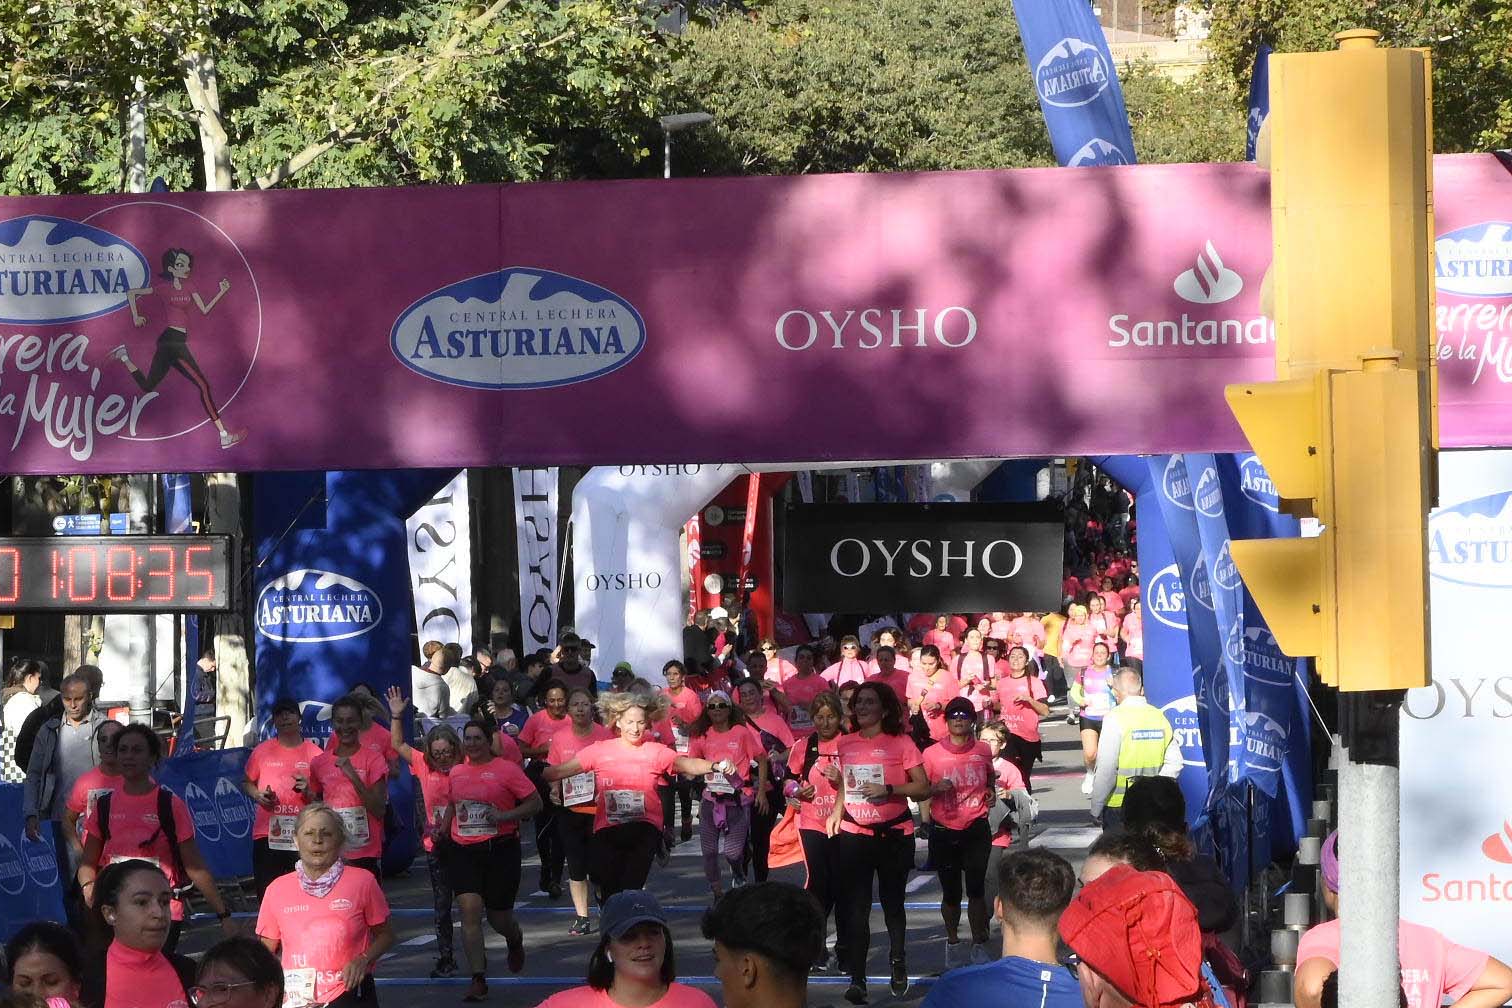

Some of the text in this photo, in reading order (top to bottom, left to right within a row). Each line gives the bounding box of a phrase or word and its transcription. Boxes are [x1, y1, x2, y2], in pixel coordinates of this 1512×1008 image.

[53, 252, 124, 263] LECHERA
[1435, 256, 1512, 278] ASTUR
[449, 308, 618, 323] CENTRAL LECHERA
[775, 306, 978, 351] OYSHO
[1436, 303, 1512, 333] arrer
[411, 315, 626, 361] ASTURIANA
[1458, 333, 1476, 360] la
[11, 366, 160, 461] Mujer
[830, 537, 1023, 579] OYSHO
[586, 571, 662, 593] OYSHO
[273, 592, 370, 603] CENTRAL LECHERA
[260, 598, 374, 626] ASTURIANA
